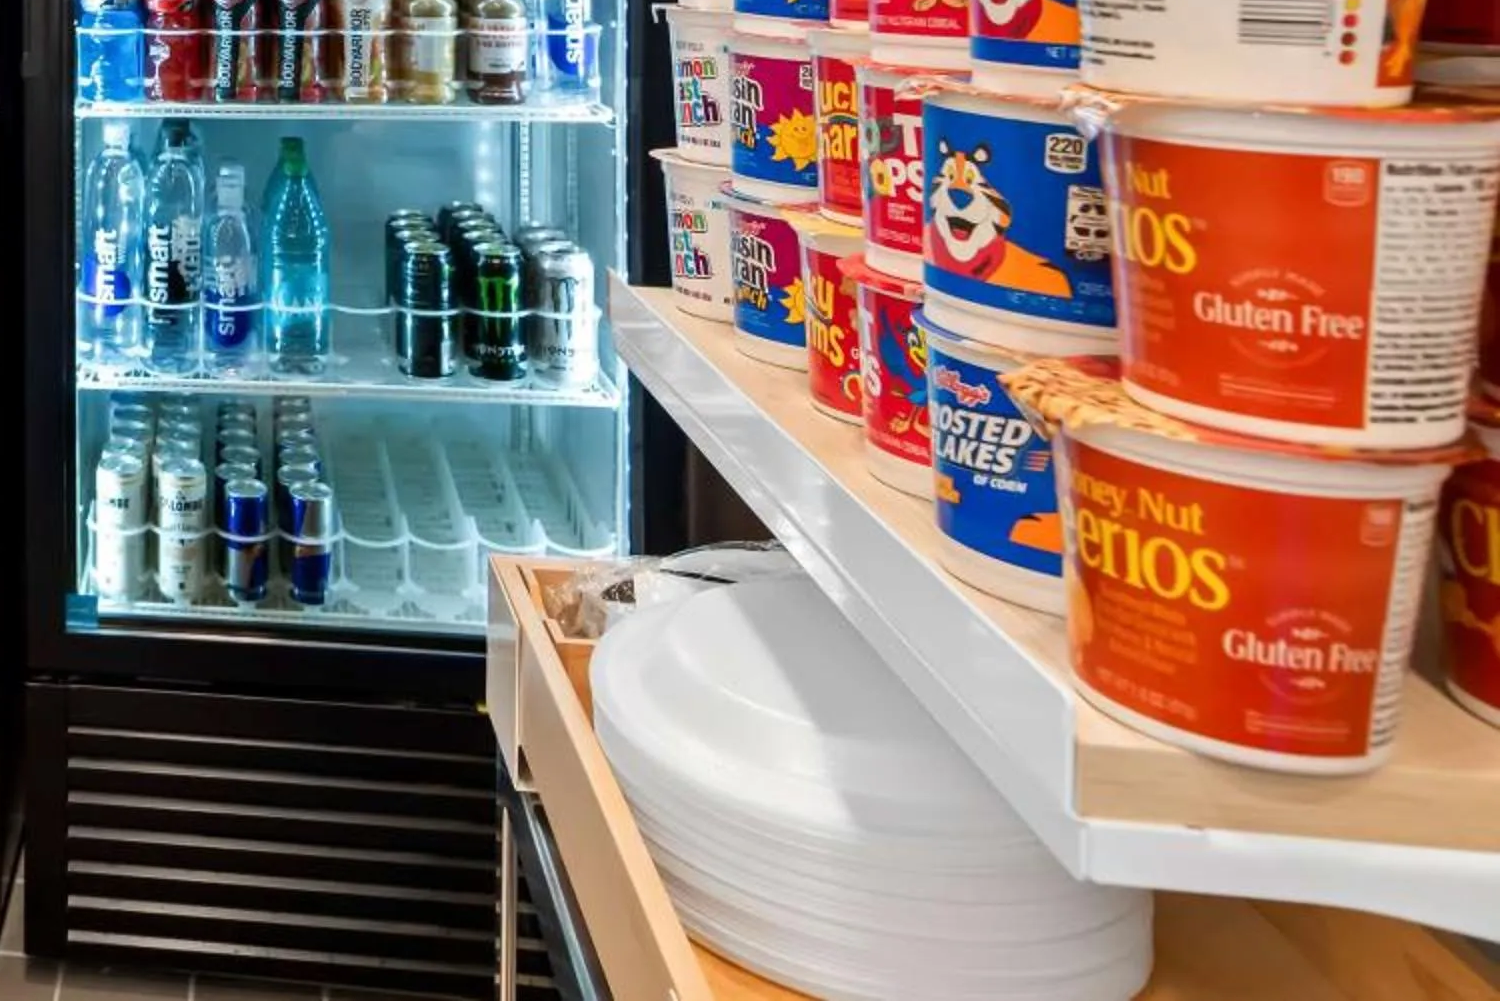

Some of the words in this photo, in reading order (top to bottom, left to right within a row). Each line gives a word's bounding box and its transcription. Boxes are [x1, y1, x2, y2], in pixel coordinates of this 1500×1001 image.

[1049, 136, 1083, 153] 220
[150, 224, 171, 302] smart
[1193, 291, 1294, 334] Gluten
[1301, 305, 1365, 340] Free
[973, 474, 989, 486] OF
[1137, 487, 1205, 536] Nut
[1222, 629, 1324, 672] Gluten
